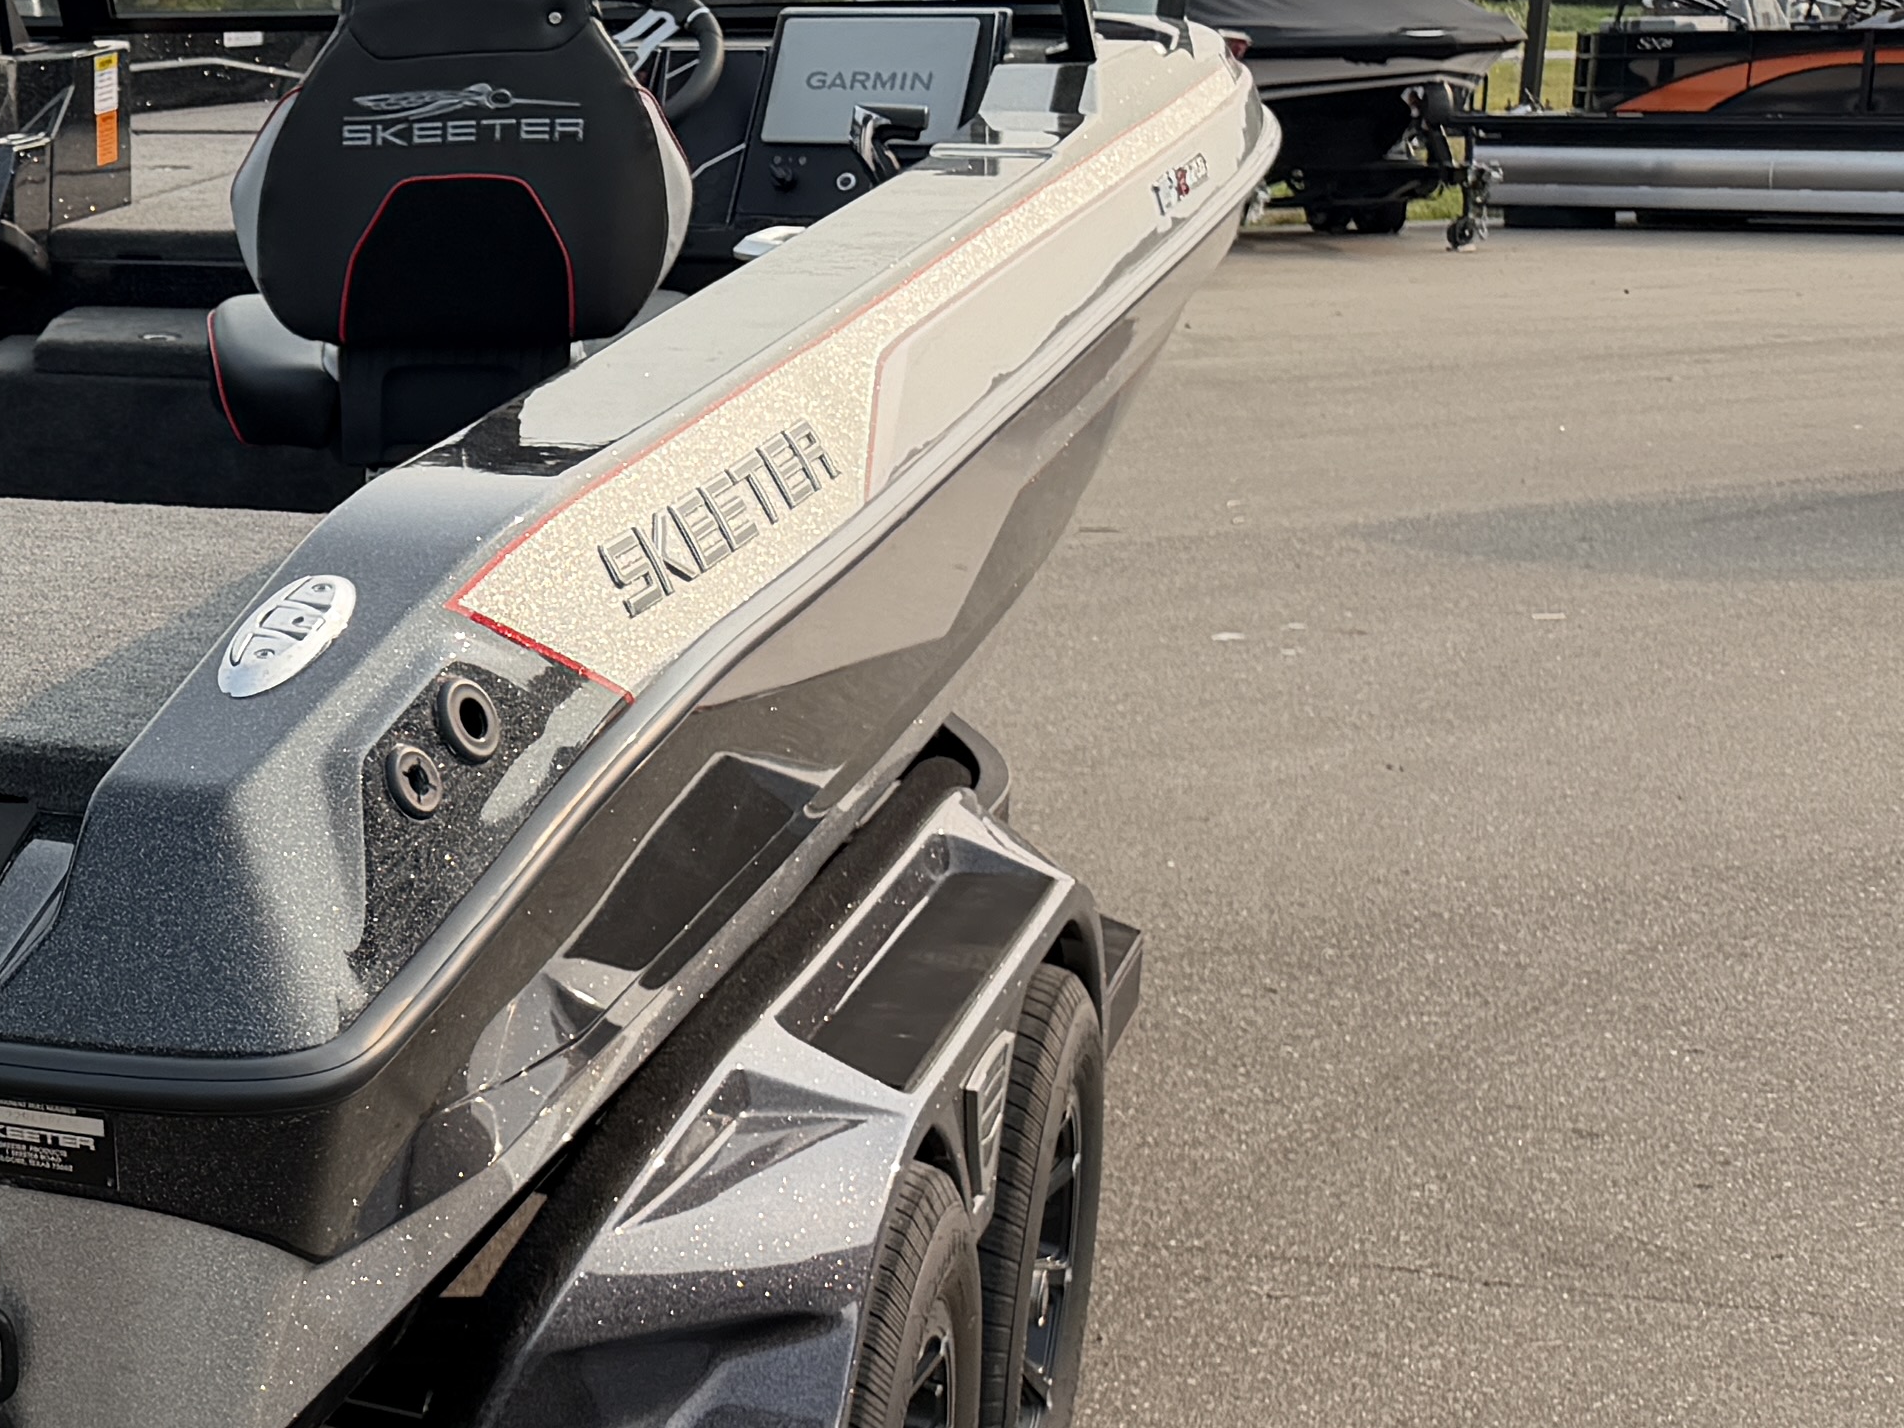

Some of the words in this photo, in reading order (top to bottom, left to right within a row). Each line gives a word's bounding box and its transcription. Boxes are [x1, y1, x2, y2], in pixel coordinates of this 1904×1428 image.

[806, 71, 935, 92] GARMIN
[342, 118, 585, 147] SKEETER
[597, 419, 843, 619] SKEETER
